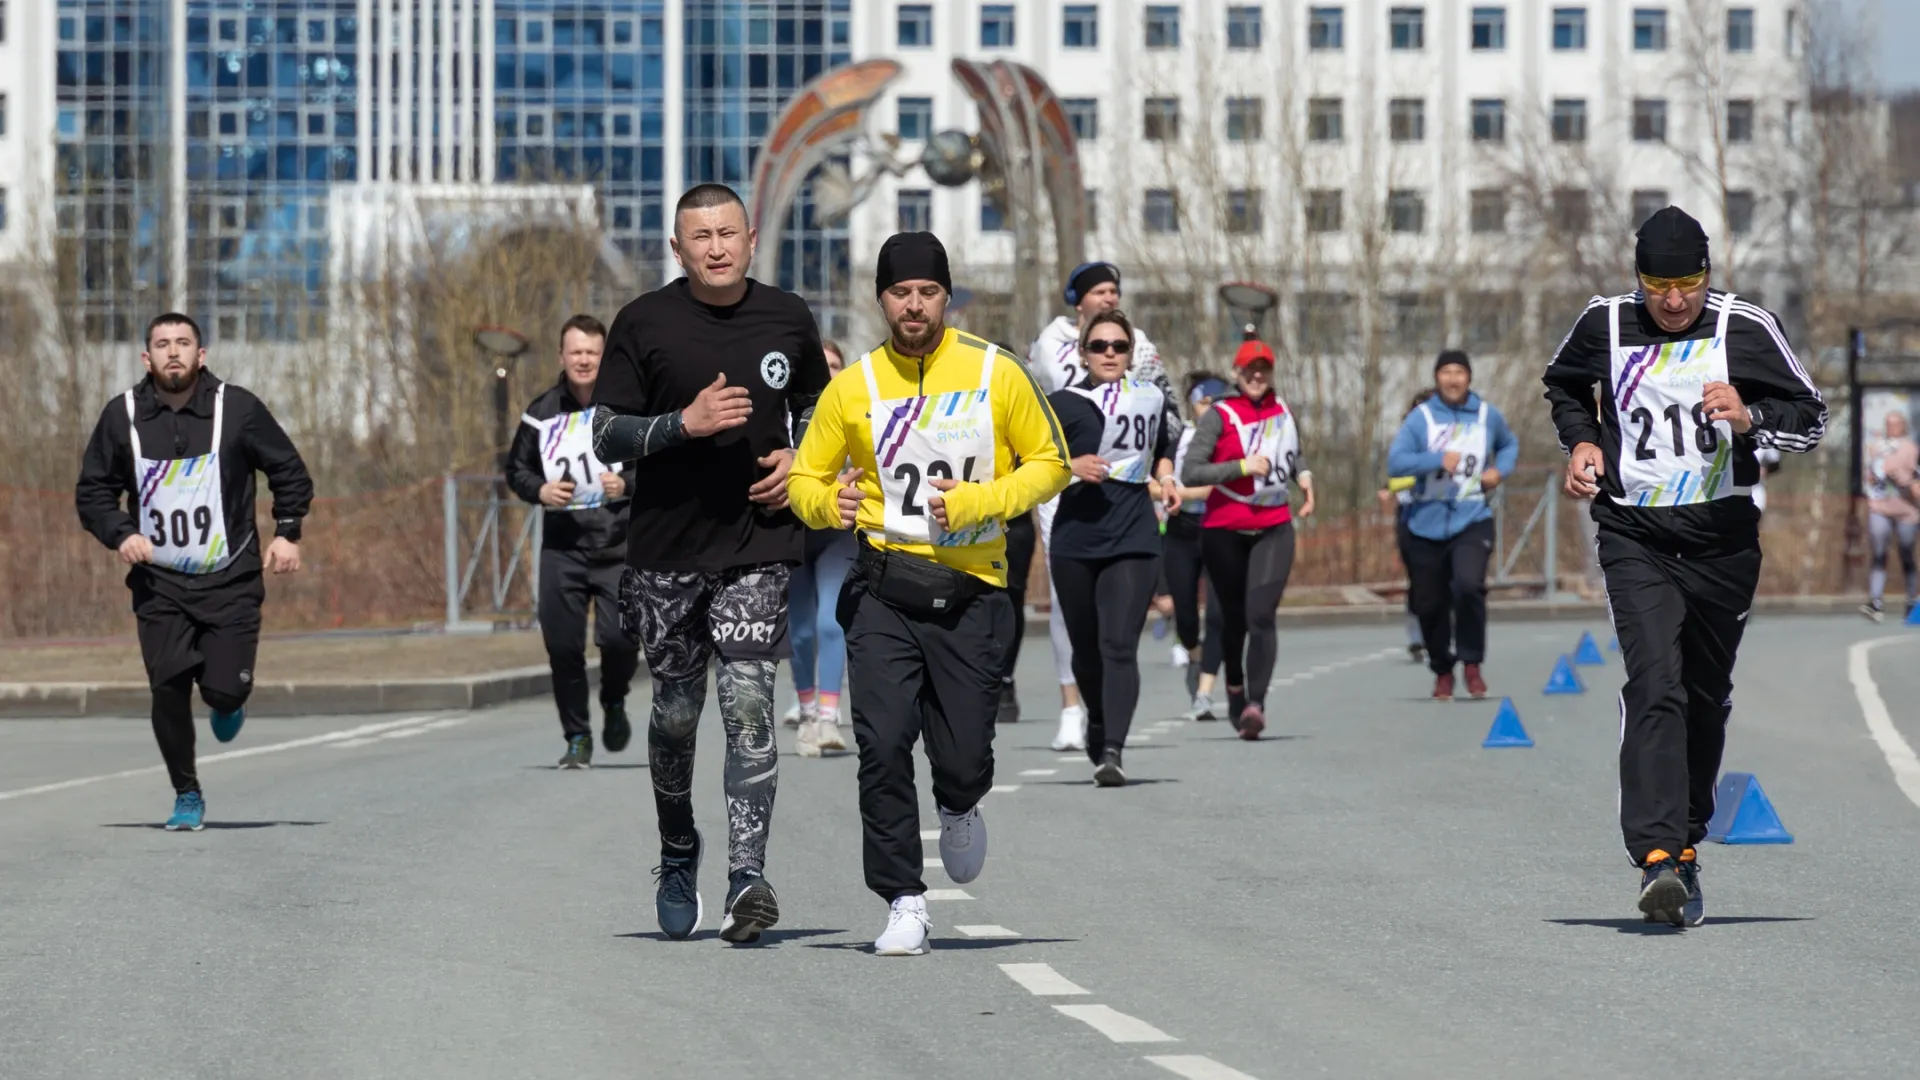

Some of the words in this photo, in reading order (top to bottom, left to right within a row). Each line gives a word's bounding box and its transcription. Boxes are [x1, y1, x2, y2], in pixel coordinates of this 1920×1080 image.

[937, 428, 981, 443] ЯМАЛ
[1630, 401, 1717, 461] 218
[555, 452, 613, 486] 21
[149, 504, 212, 548] 309
[711, 620, 776, 644] SPORT
